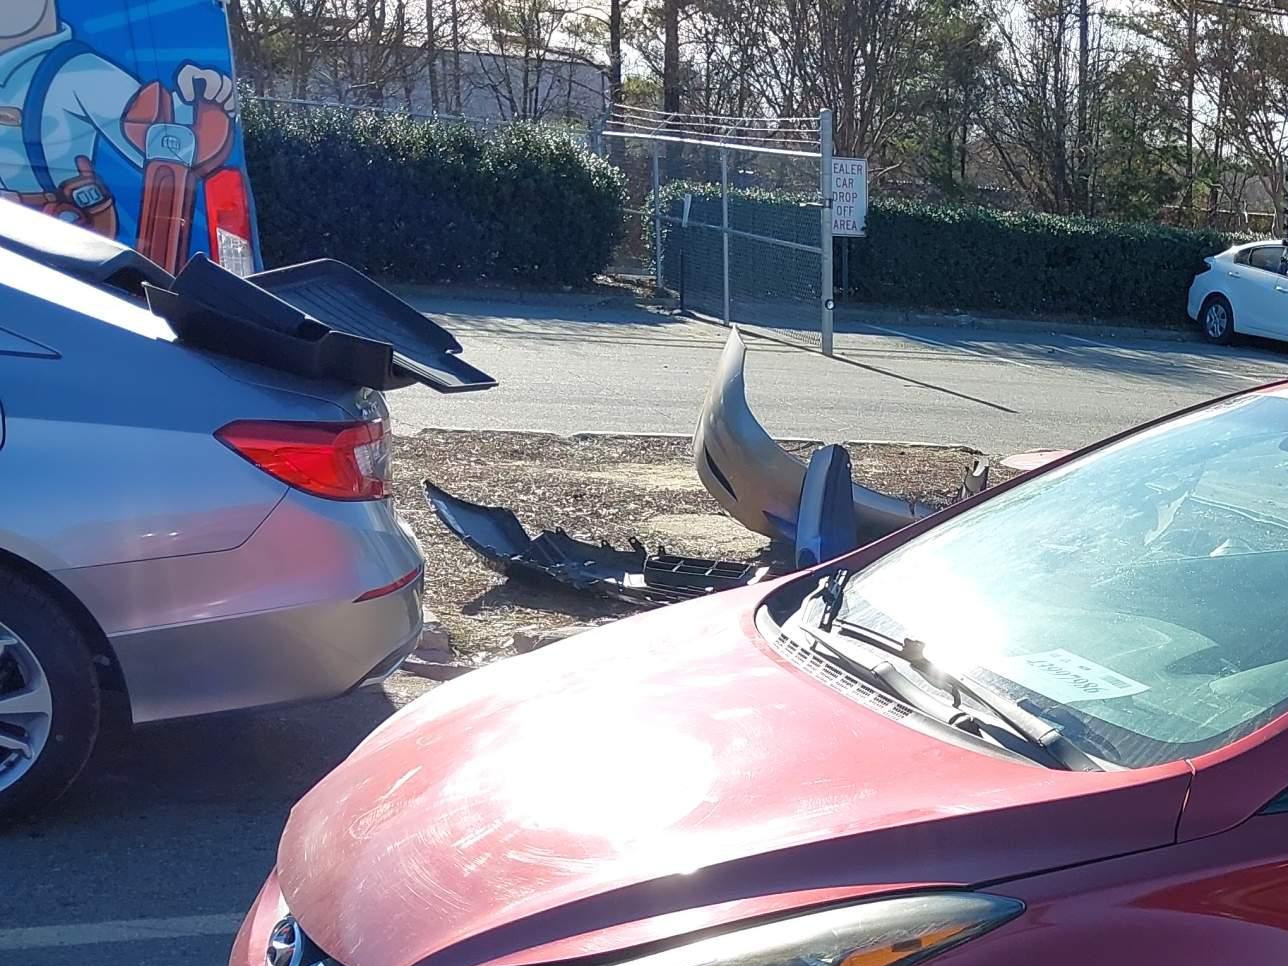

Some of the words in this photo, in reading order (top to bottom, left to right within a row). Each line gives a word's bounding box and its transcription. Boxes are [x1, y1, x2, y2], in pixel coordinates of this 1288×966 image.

[833, 163, 863, 175] EALER
[836, 177, 854, 189] CAR
[833, 191, 858, 203] DROP
[837, 205, 855, 217] OFF
[833, 219, 858, 231] AREA
